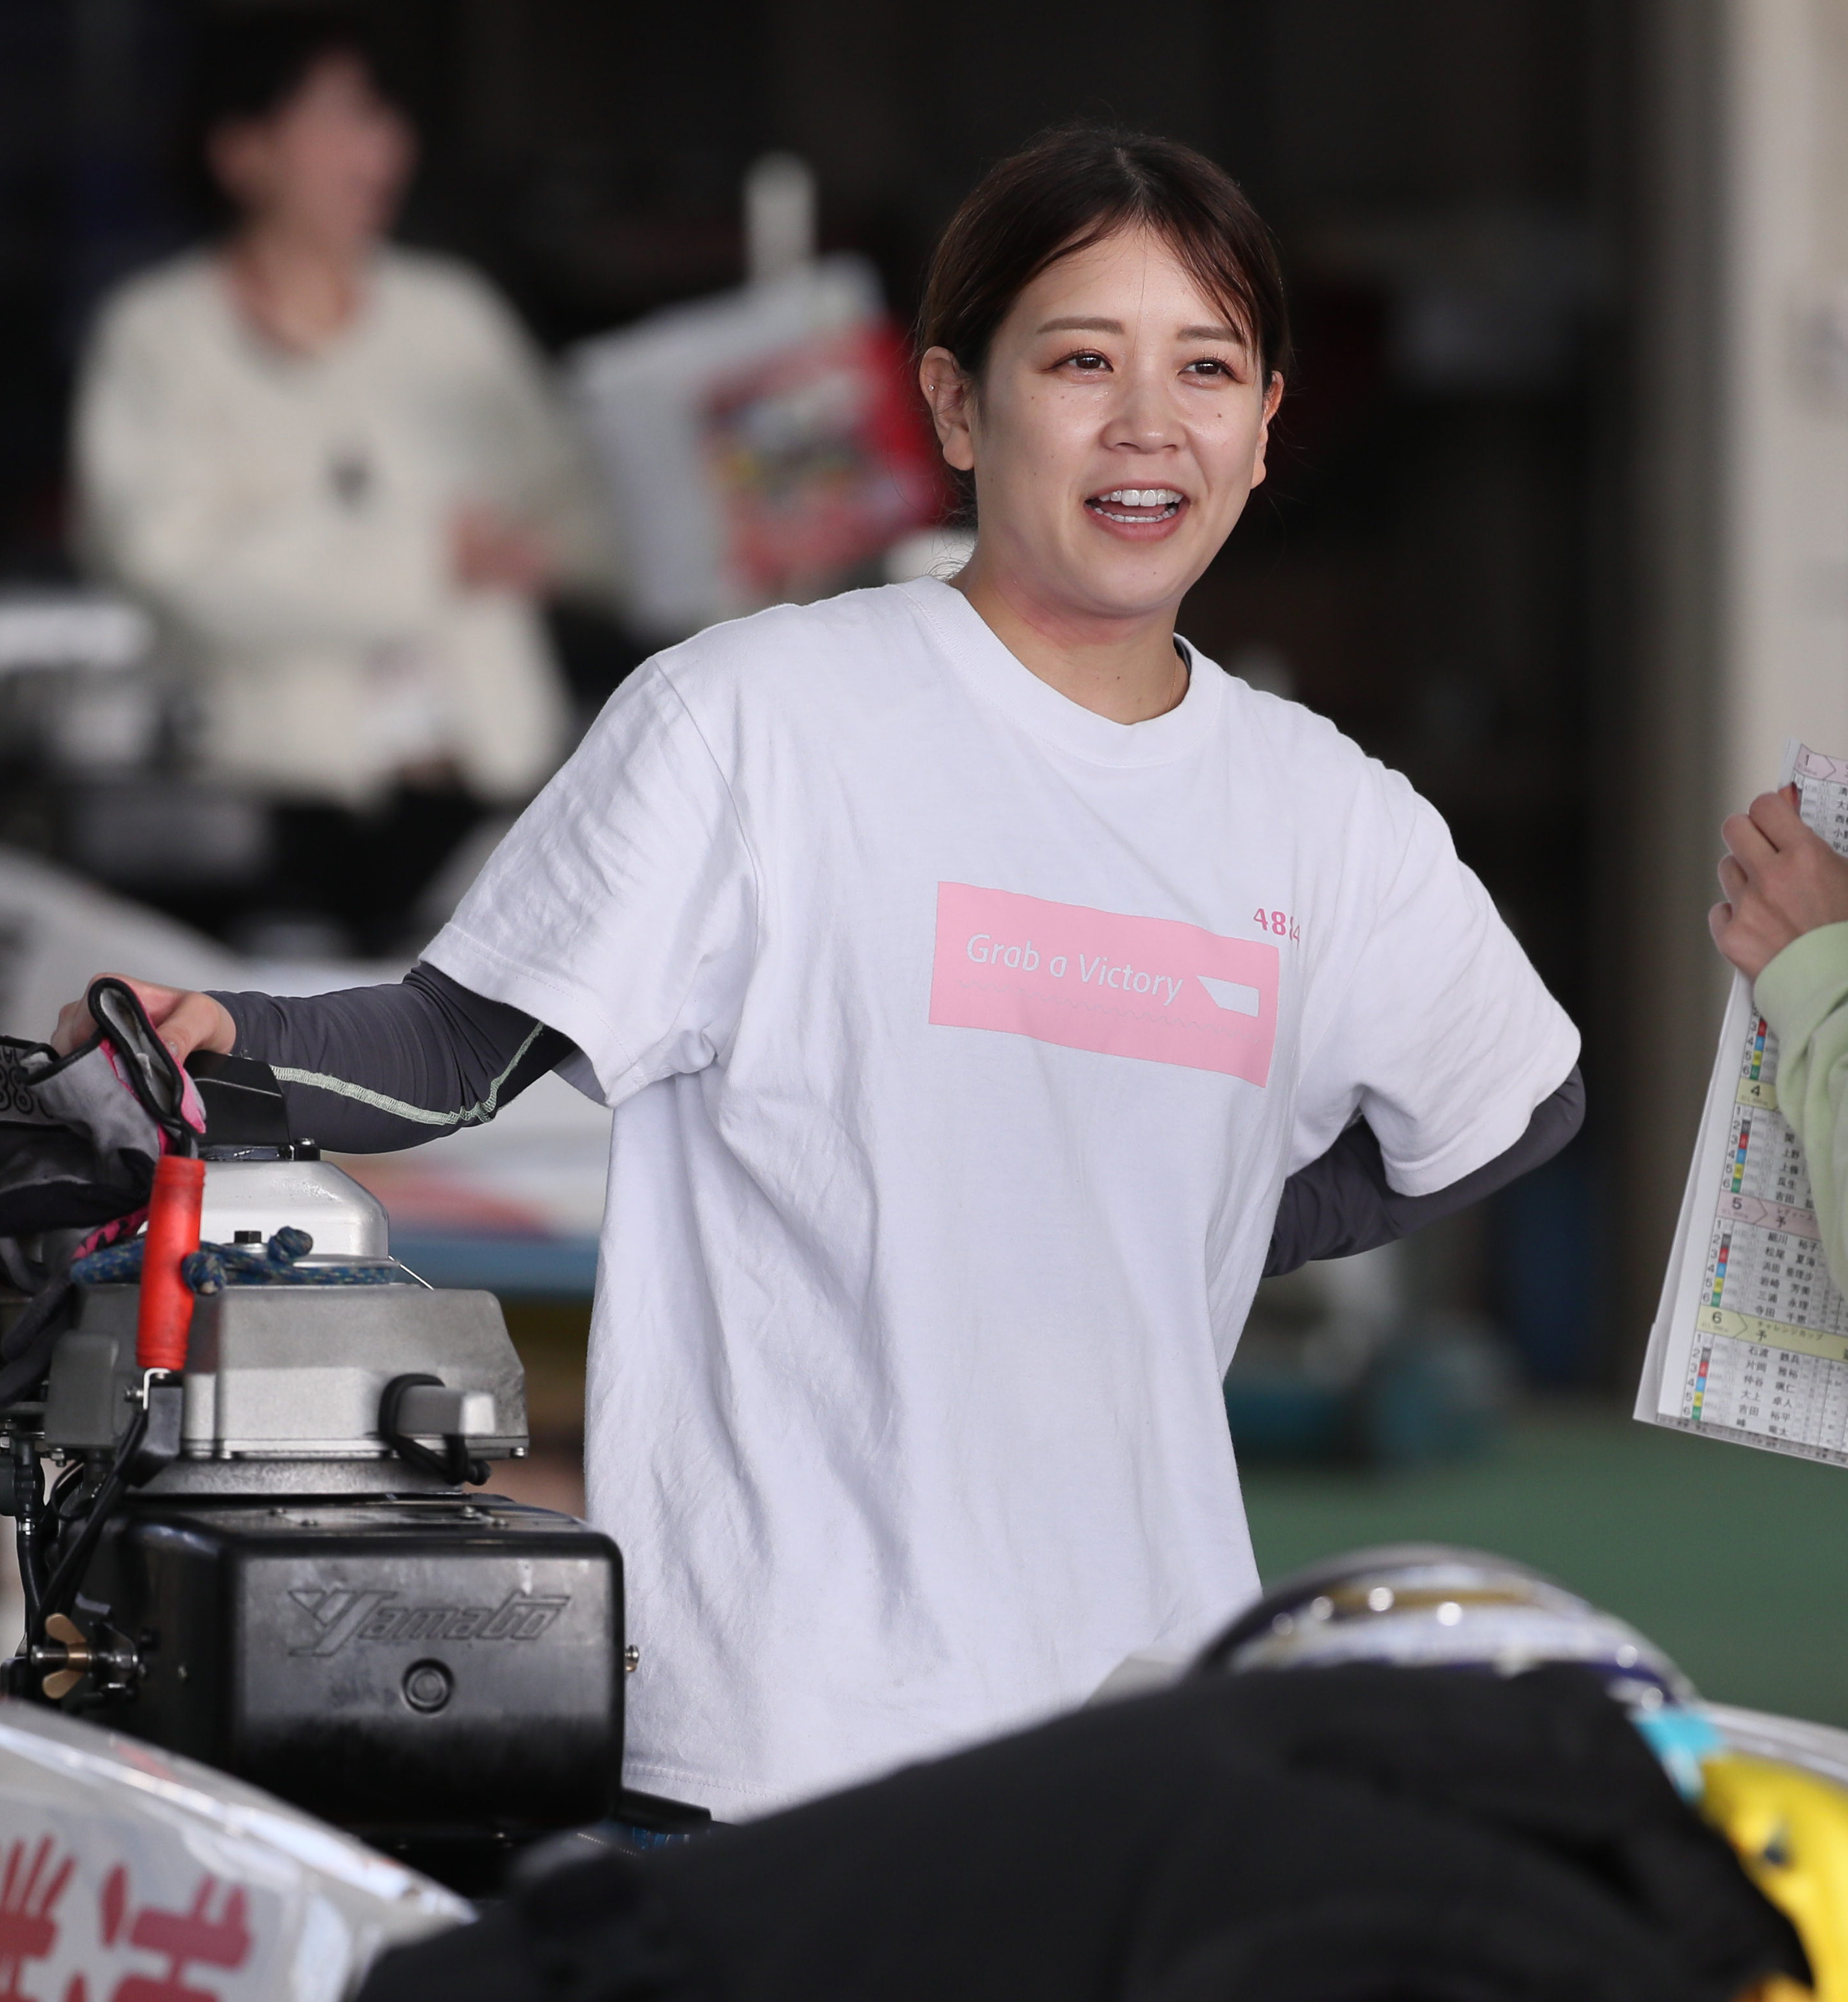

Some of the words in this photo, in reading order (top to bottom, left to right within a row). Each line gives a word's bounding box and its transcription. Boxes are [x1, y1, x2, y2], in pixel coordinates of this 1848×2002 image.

[966, 933, 1040, 971] Grab
[1049, 956, 1068, 979] a
[1079, 953, 1184, 1006] Victory
[1750, 1084, 1761, 1097] 4
[1732, 1198, 1742, 1210] 5
[1712, 1311, 1723, 1324] 6
[1741, 1390, 1761, 1402] 大上
